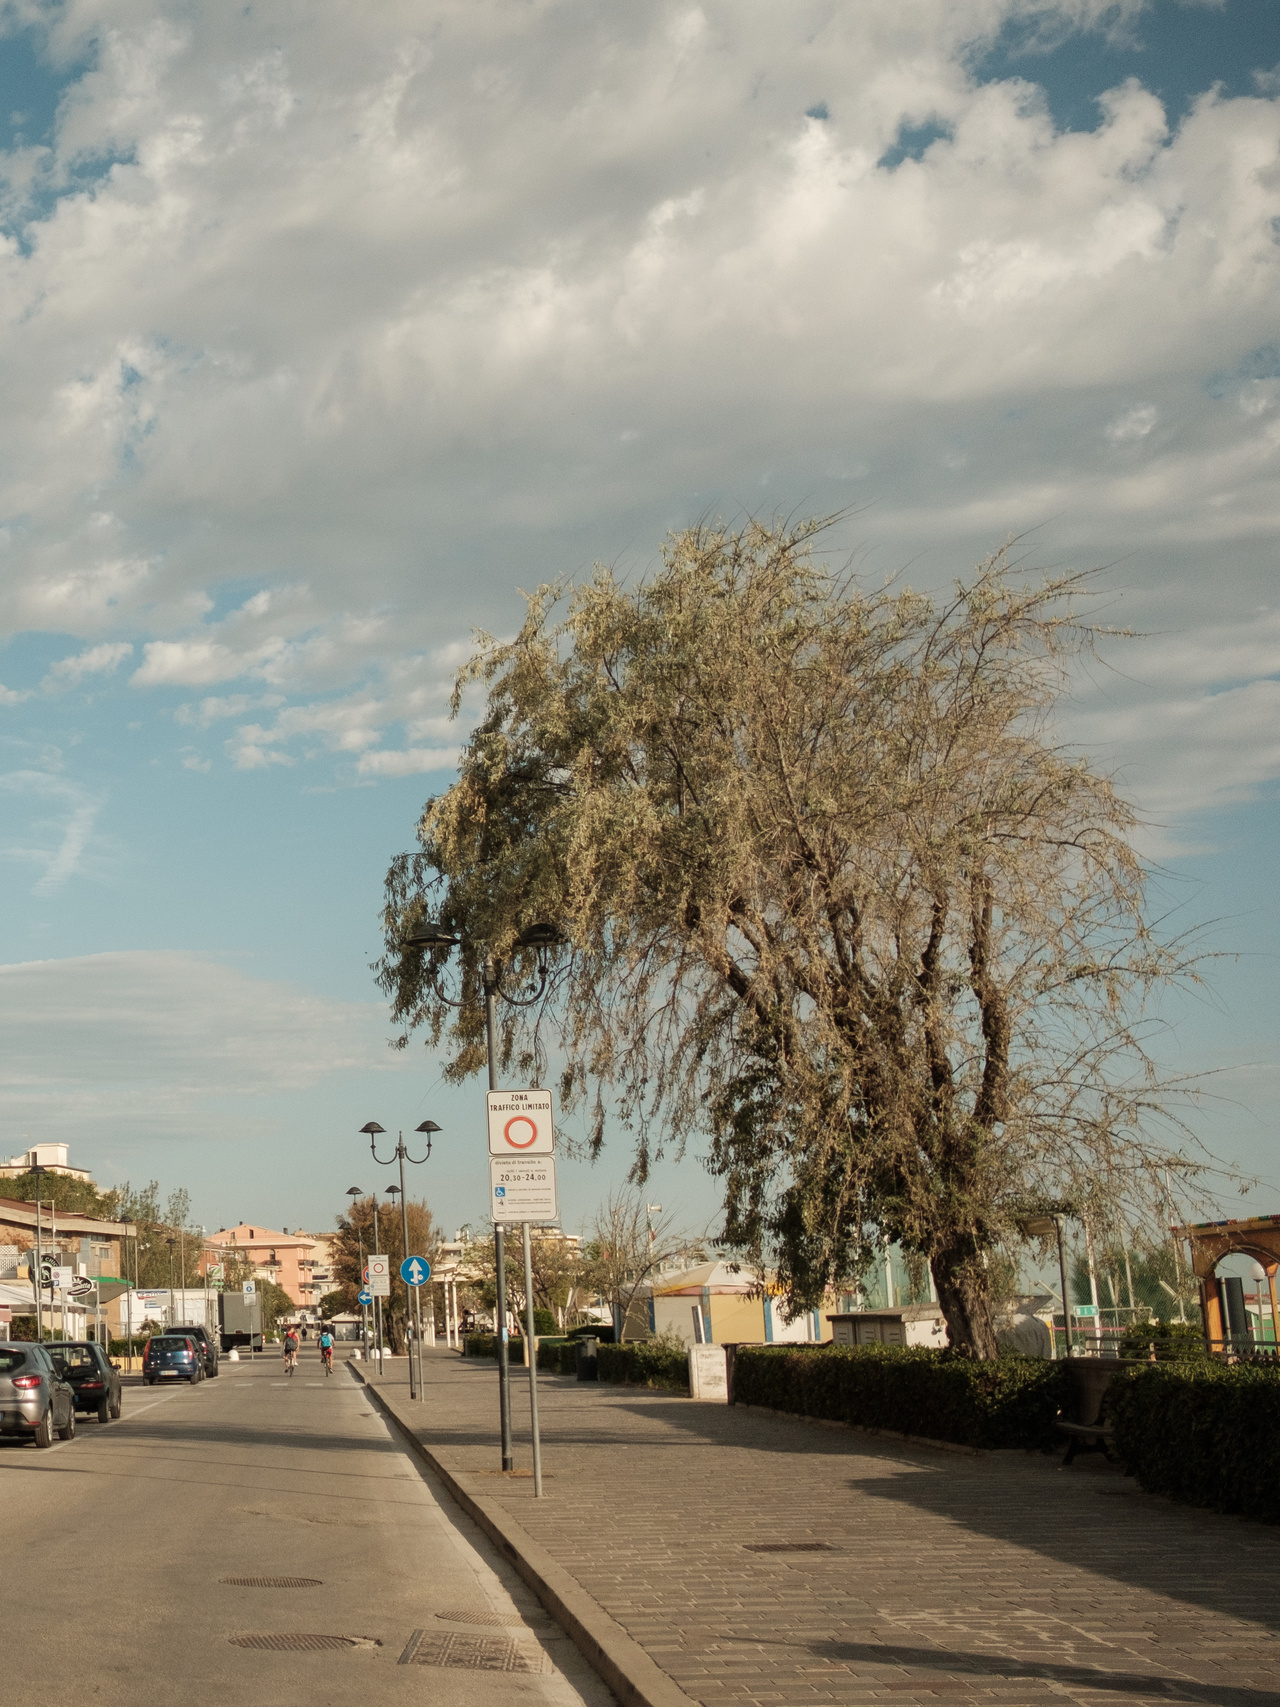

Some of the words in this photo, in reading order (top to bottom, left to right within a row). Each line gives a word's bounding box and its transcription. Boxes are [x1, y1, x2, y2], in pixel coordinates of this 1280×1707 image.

[510, 1094, 529, 1102] ZONA
[489, 1104, 520, 1112] TRAFFICO
[522, 1102, 550, 1111] LIMITATO
